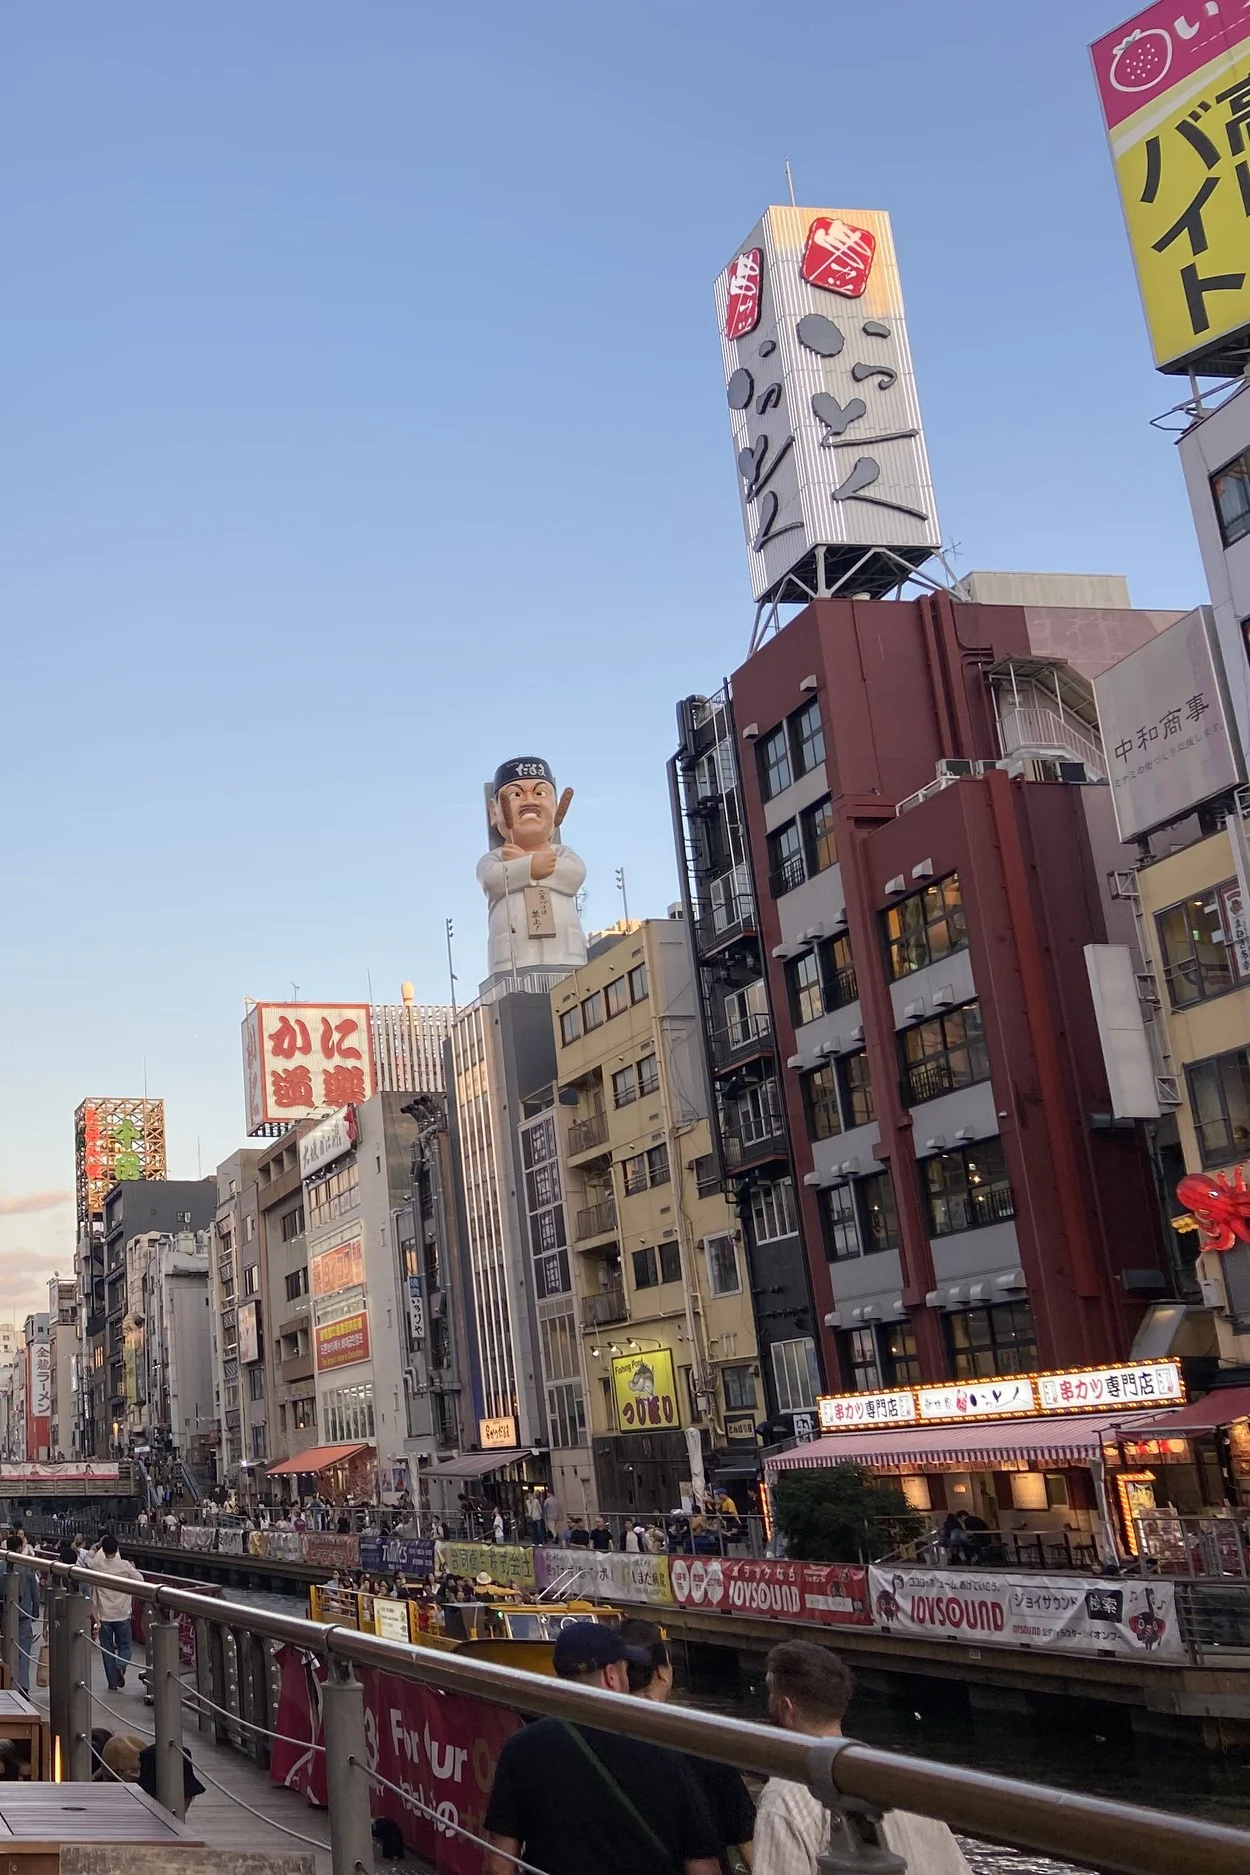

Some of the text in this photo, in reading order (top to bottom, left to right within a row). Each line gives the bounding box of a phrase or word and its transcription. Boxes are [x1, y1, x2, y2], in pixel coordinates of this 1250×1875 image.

[1140, 100, 1246, 336] バイト
[1114, 692, 1210, 763] 中和商事
[515, 763, 547, 777] だるま
[268, 1015, 363, 1060] かに
[36, 1346, 50, 1414] 金龍ラーメン
[614, 1361, 633, 1376] Fishing
[1059, 1372, 1155, 1402] 串カツ専門店
[835, 1398, 899, 1421] 串カツ専門店
[728, 1579, 800, 1612] JOYSOUND
[1089, 1595, 1117, 1615] 検索
[911, 1595, 1005, 1632] JOYSOUND
